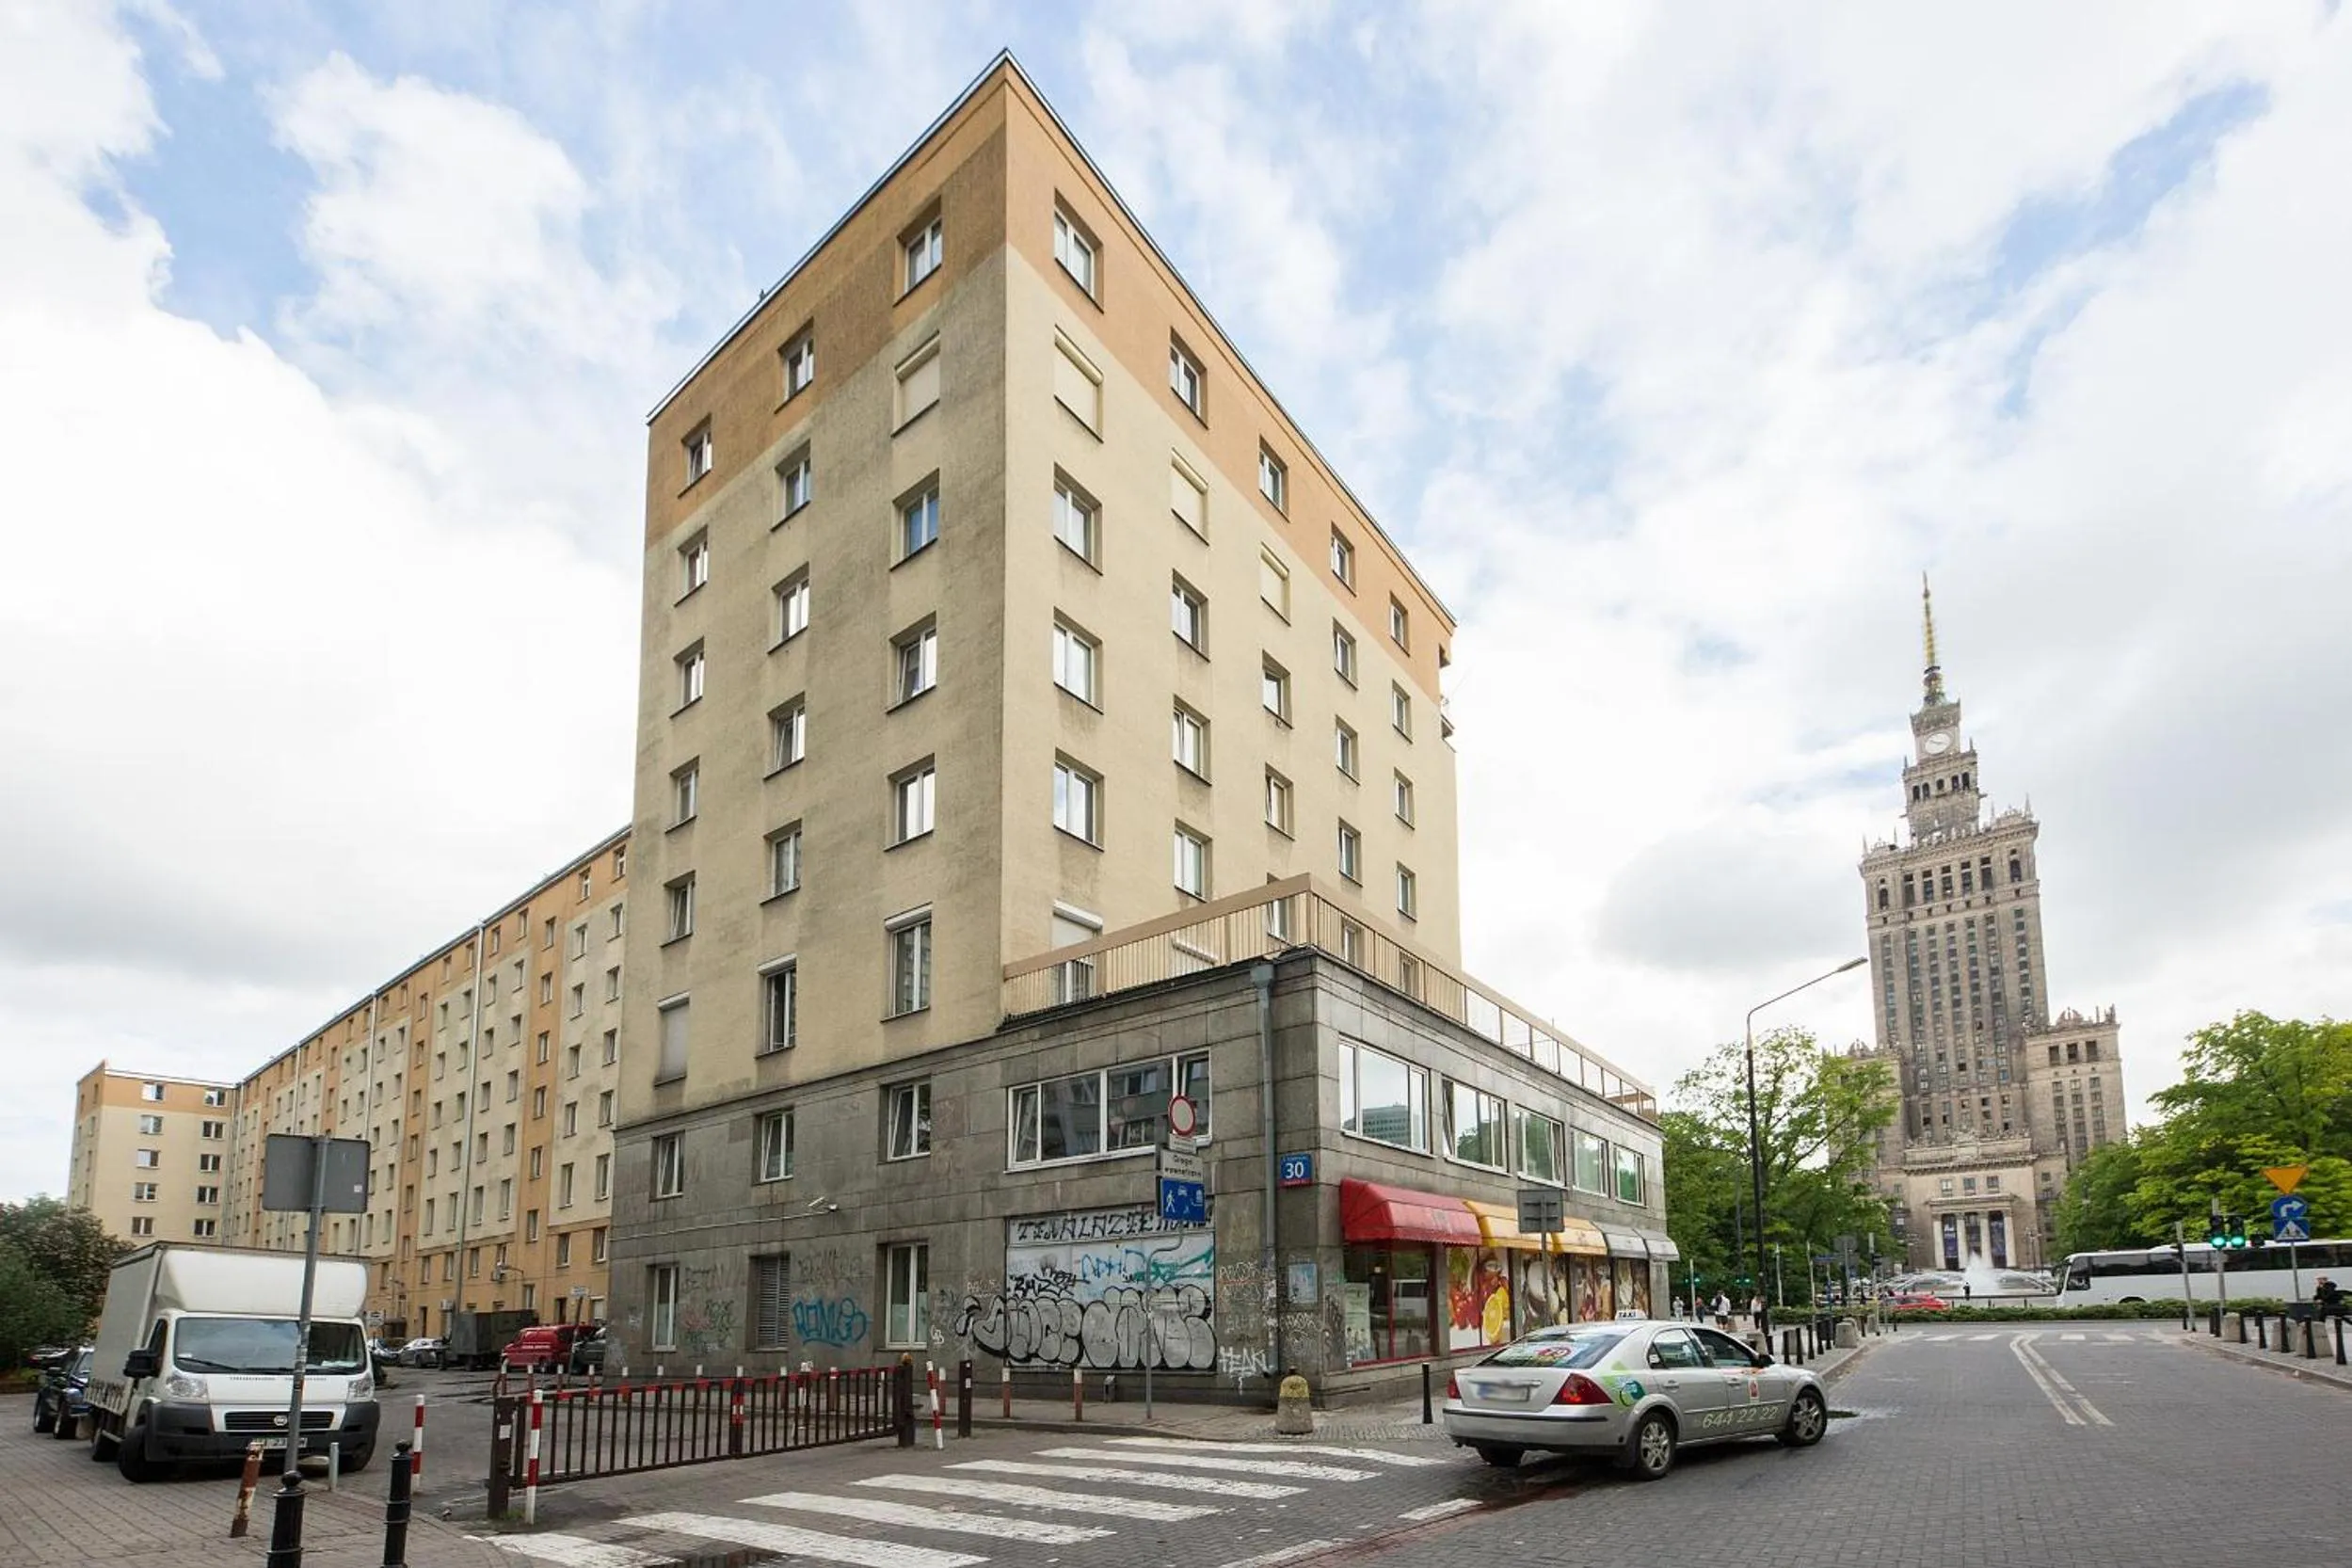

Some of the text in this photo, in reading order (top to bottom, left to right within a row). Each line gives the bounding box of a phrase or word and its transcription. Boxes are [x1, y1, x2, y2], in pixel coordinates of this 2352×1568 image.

[1285, 1161, 1304, 1178] 30
[1703, 1406, 1779, 1429] 644 22 22
